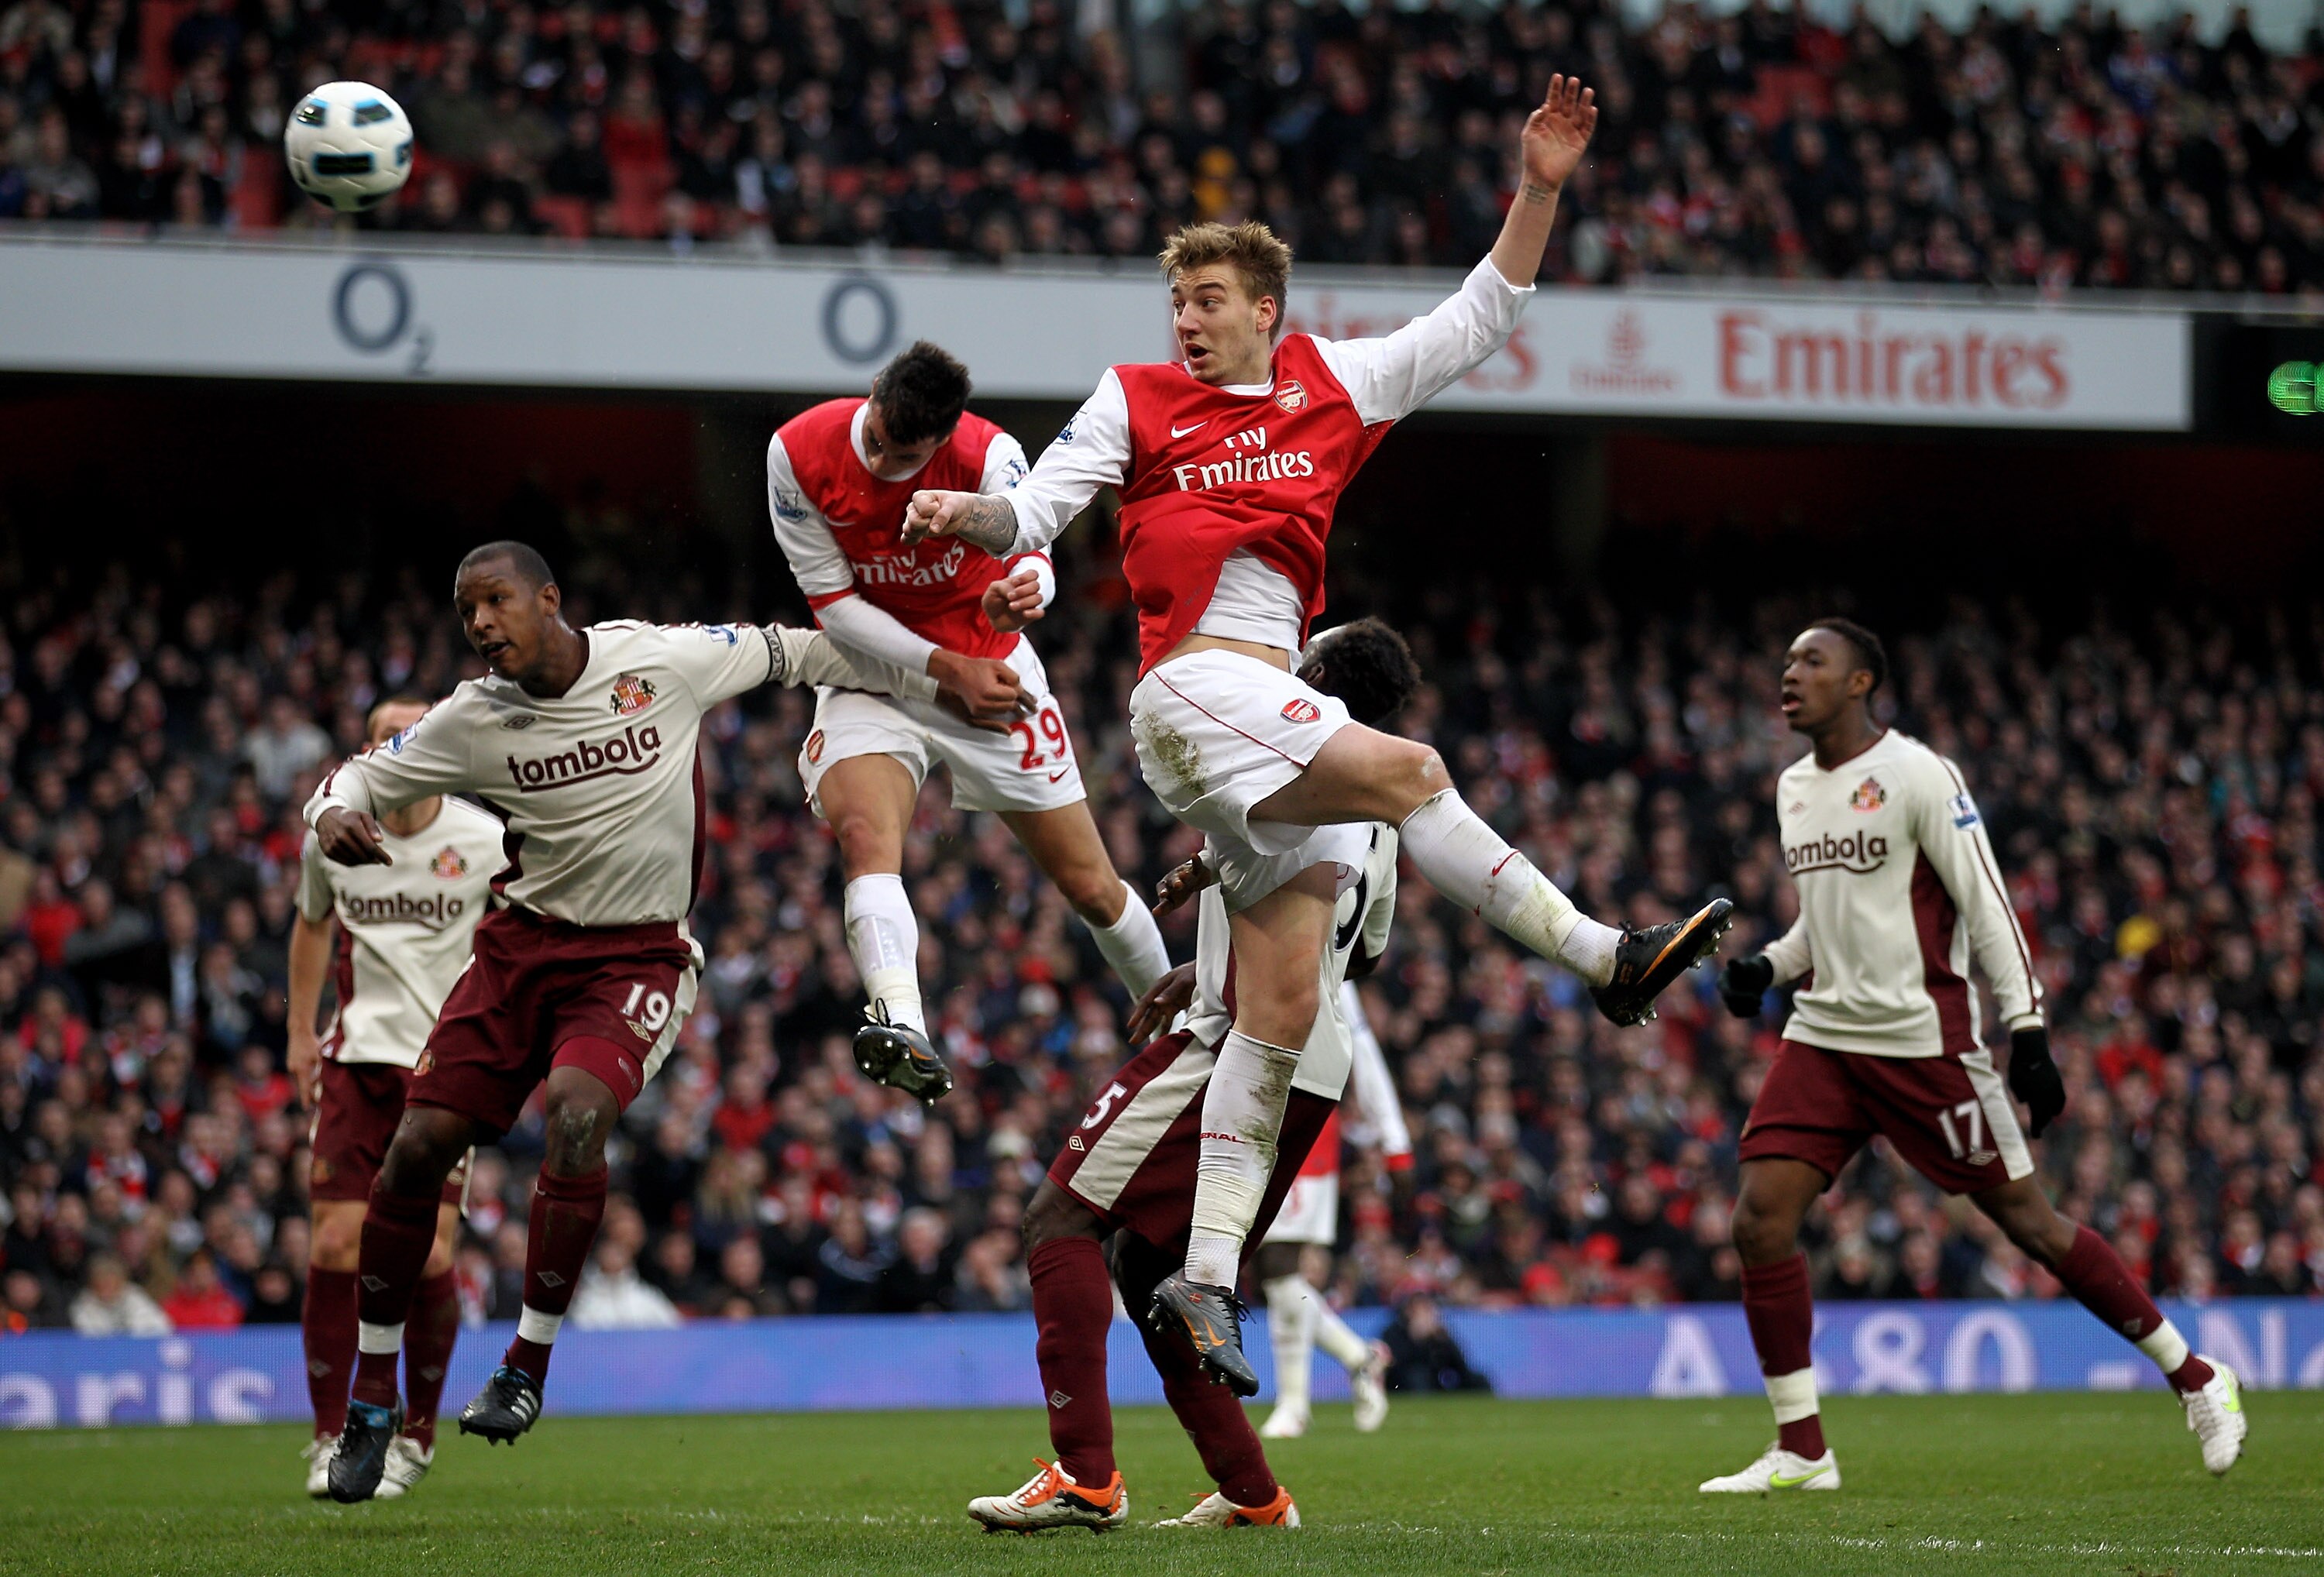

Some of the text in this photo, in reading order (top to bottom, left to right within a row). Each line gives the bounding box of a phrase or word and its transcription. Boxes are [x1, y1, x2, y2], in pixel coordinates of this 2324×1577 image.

[820, 271, 900, 367] O
[1717, 311, 2071, 407] Emirates
[1172, 450, 1314, 492] Emirates
[851, 540, 964, 586] mirates
[765, 633, 781, 663] CAPT
[507, 726, 662, 785] tombola
[1008, 708, 1067, 771] 29
[1782, 830, 1887, 868] ombola
[620, 981, 671, 1032] 19
[1081, 1081, 1128, 1130] 5
[1937, 1100, 1982, 1160] 17
[1200, 1132, 1246, 1144] ENAL
[1648, 1309, 2040, 1397] A80
